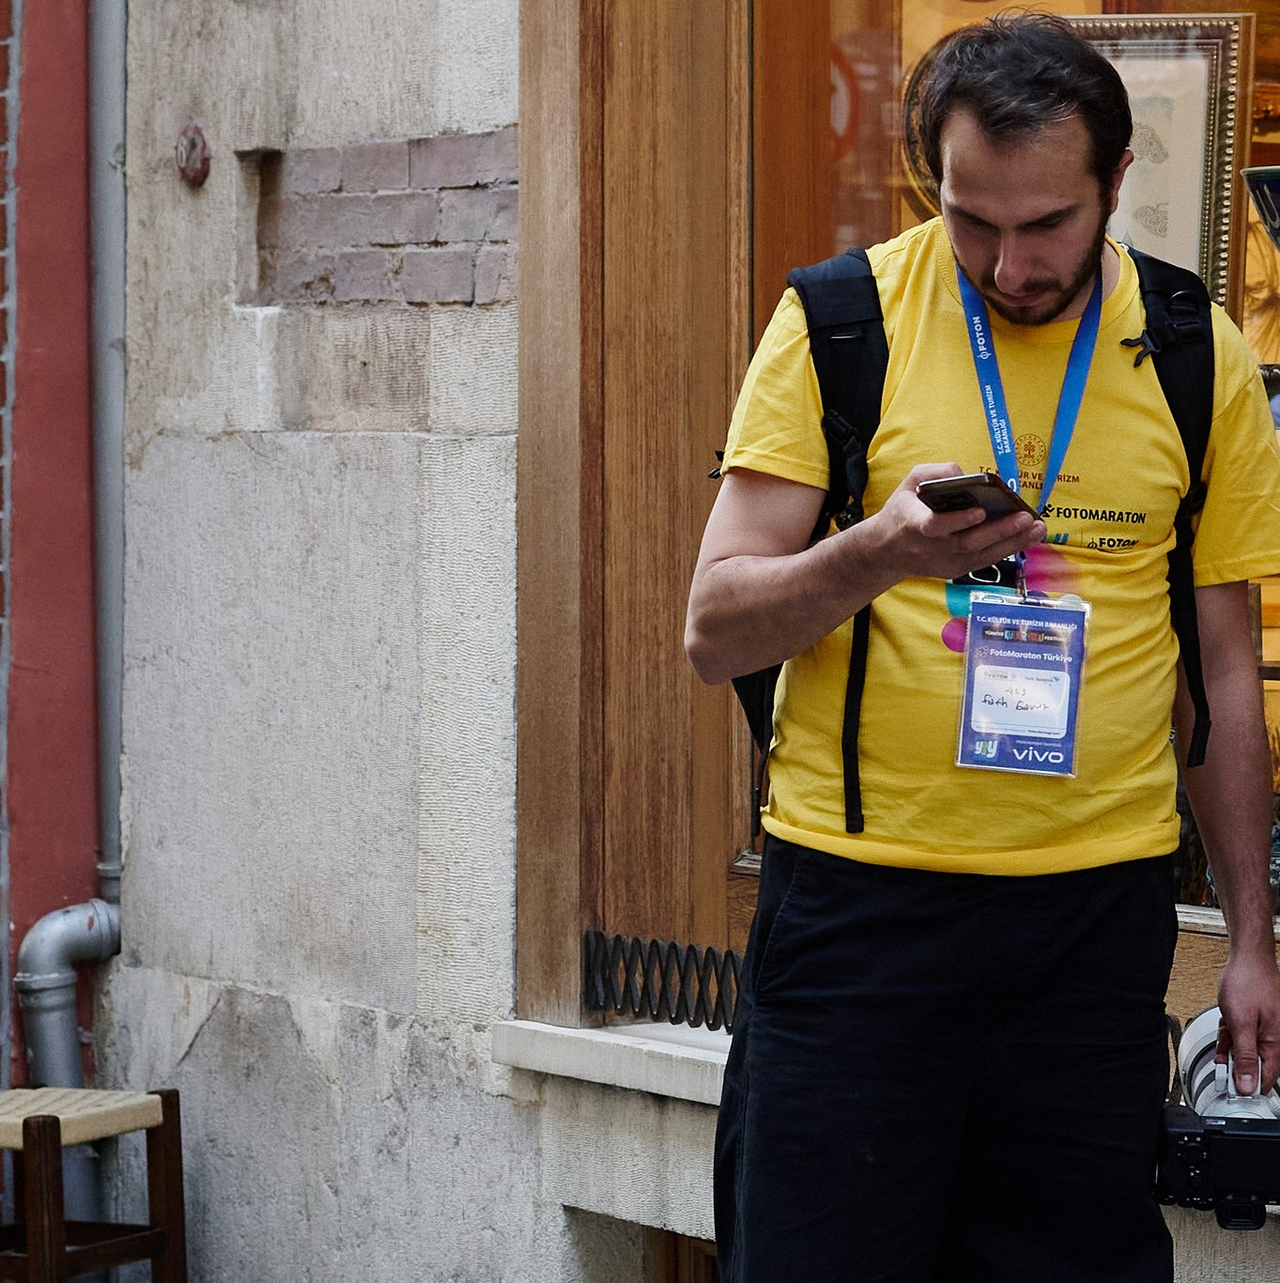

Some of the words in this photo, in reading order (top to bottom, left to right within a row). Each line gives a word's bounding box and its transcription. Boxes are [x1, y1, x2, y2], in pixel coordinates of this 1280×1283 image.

[973, 316, 987, 352] FOTON
[1057, 474, 1080, 484] RİZM
[1056, 507, 1147, 524] FOTOMARATON
[1098, 538, 1140, 548] FOTON
[990, 648, 1042, 660] FotoMaraton
[1012, 746, 1064, 763] vivo
